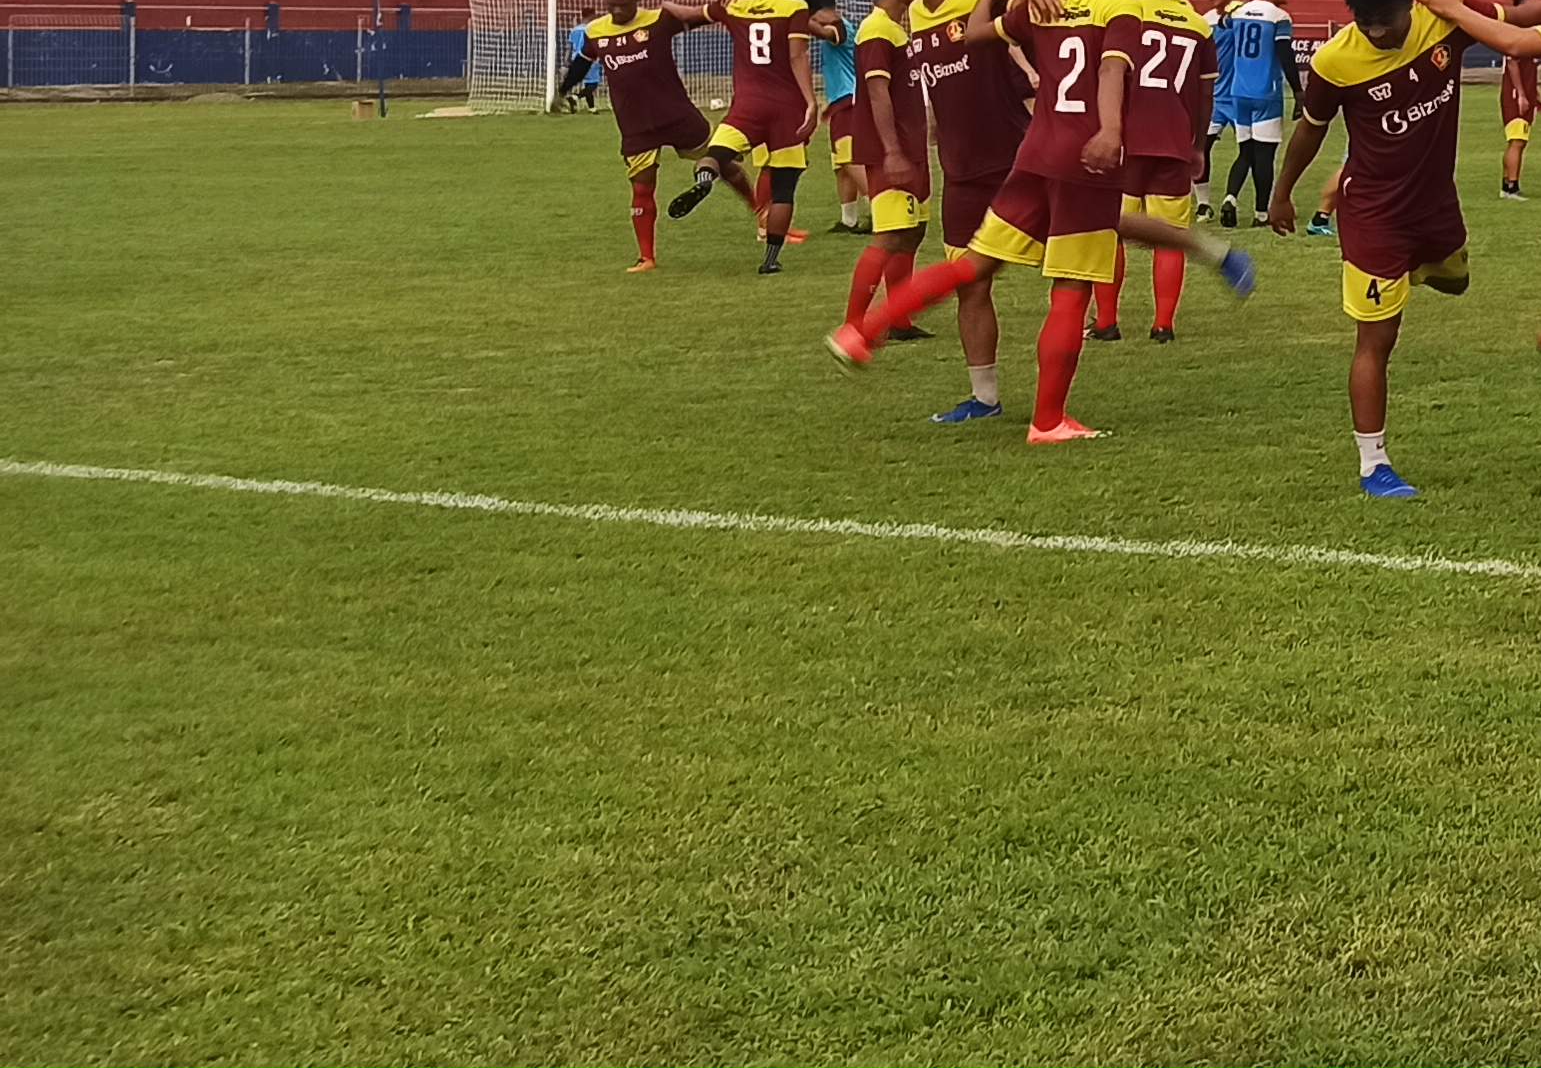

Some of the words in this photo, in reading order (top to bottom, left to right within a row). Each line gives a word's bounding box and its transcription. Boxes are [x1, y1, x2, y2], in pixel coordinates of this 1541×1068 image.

[749, 22, 771, 65] 8
[1139, 29, 1197, 94] 27
[1237, 22, 1262, 59] 18
[1054, 36, 1086, 113] 2
[1366, 278, 1381, 306] 4
